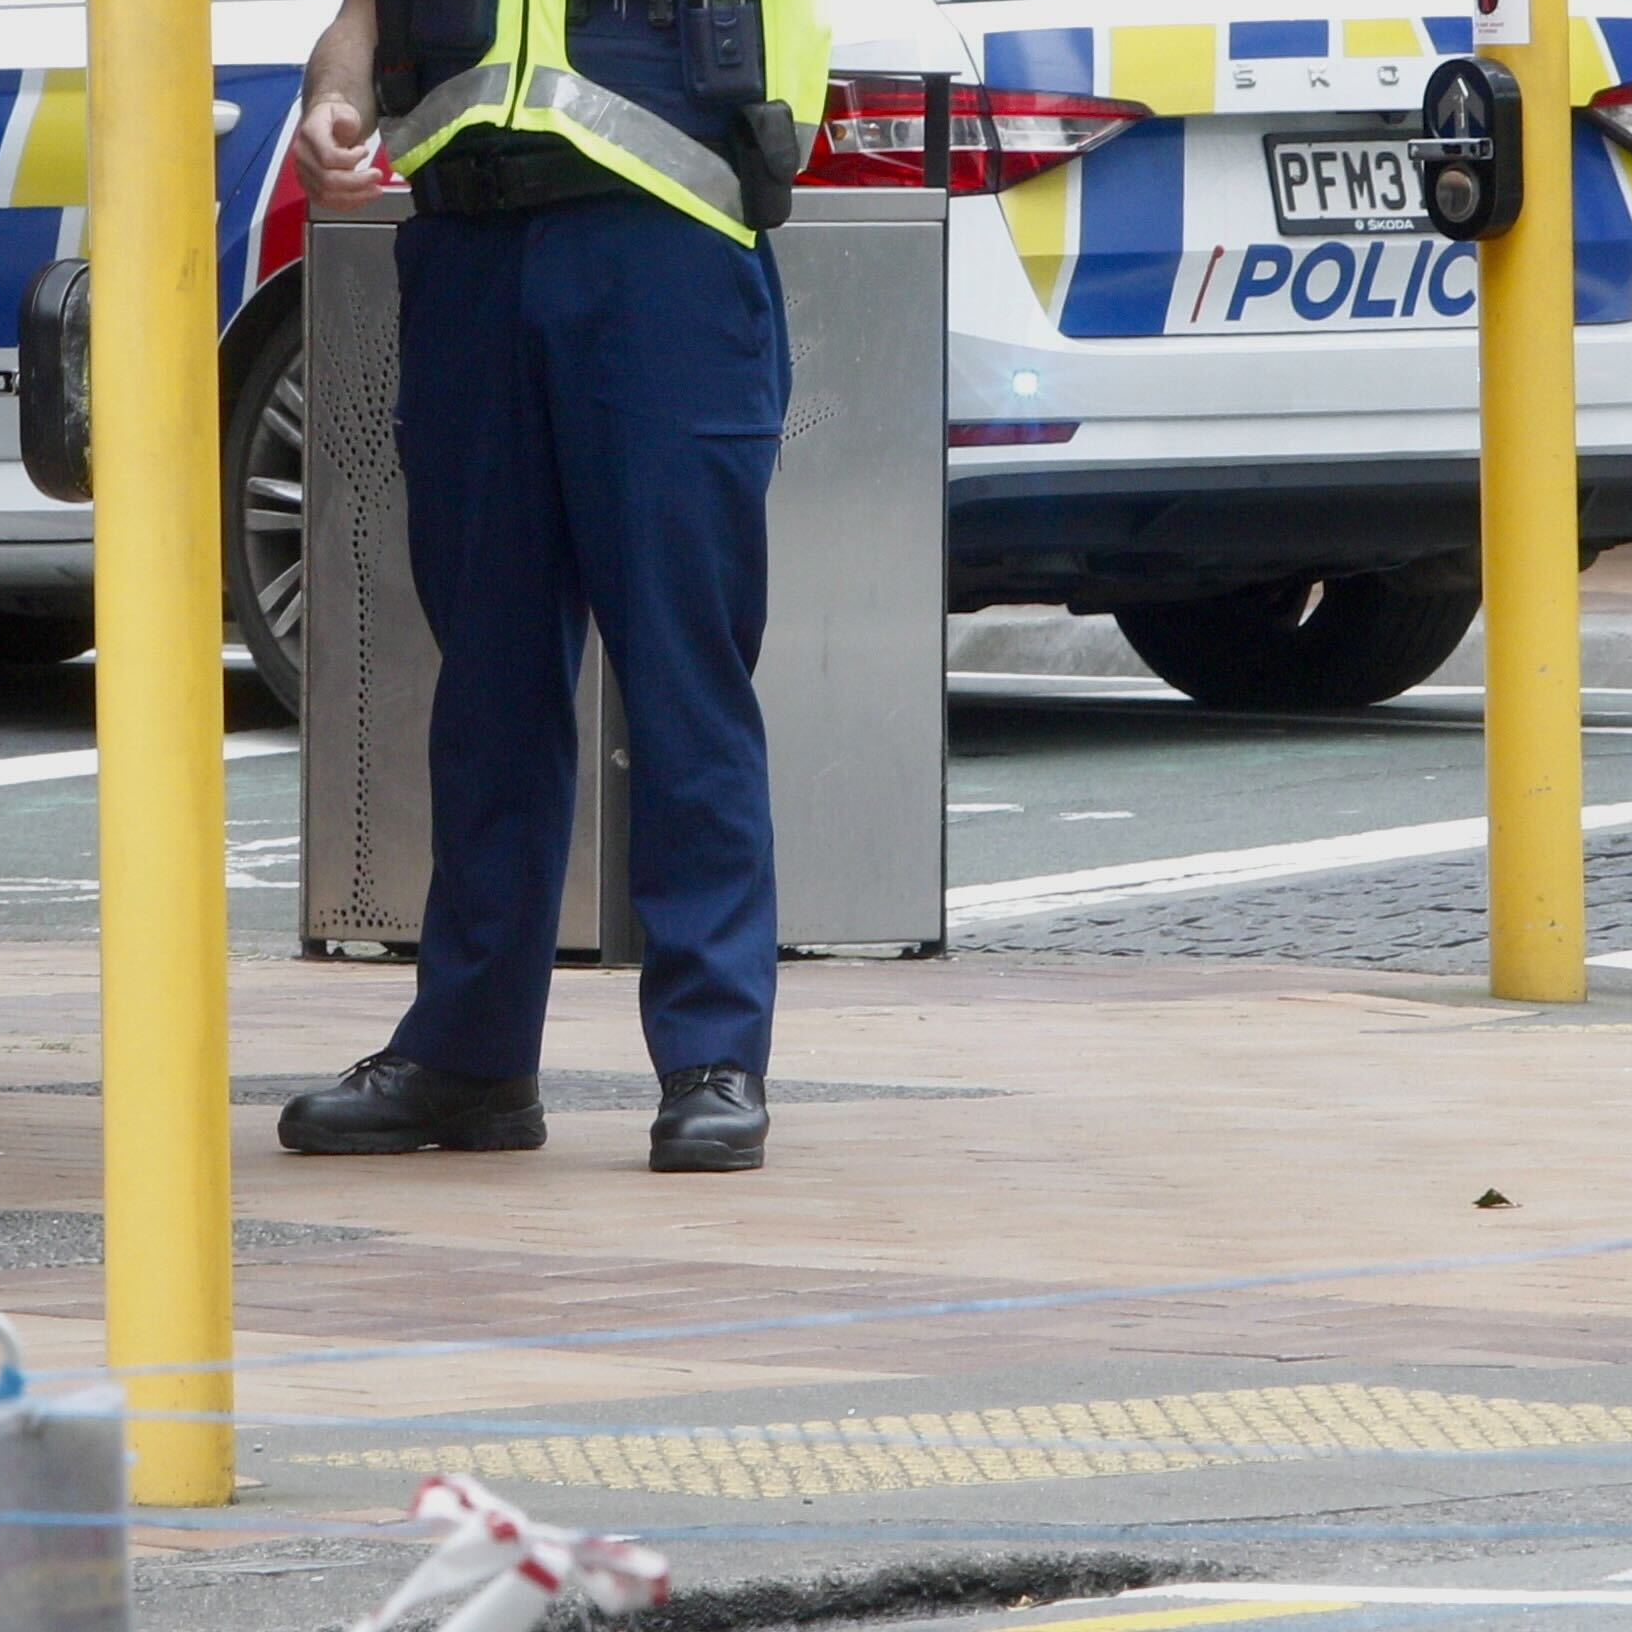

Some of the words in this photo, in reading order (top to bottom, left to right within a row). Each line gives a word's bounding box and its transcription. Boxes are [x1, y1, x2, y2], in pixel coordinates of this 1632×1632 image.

[1233, 63, 1401, 89] ŠKO
[1279, 150, 1426, 212] PFM3
[1225, 240, 1478, 322] POLIC
